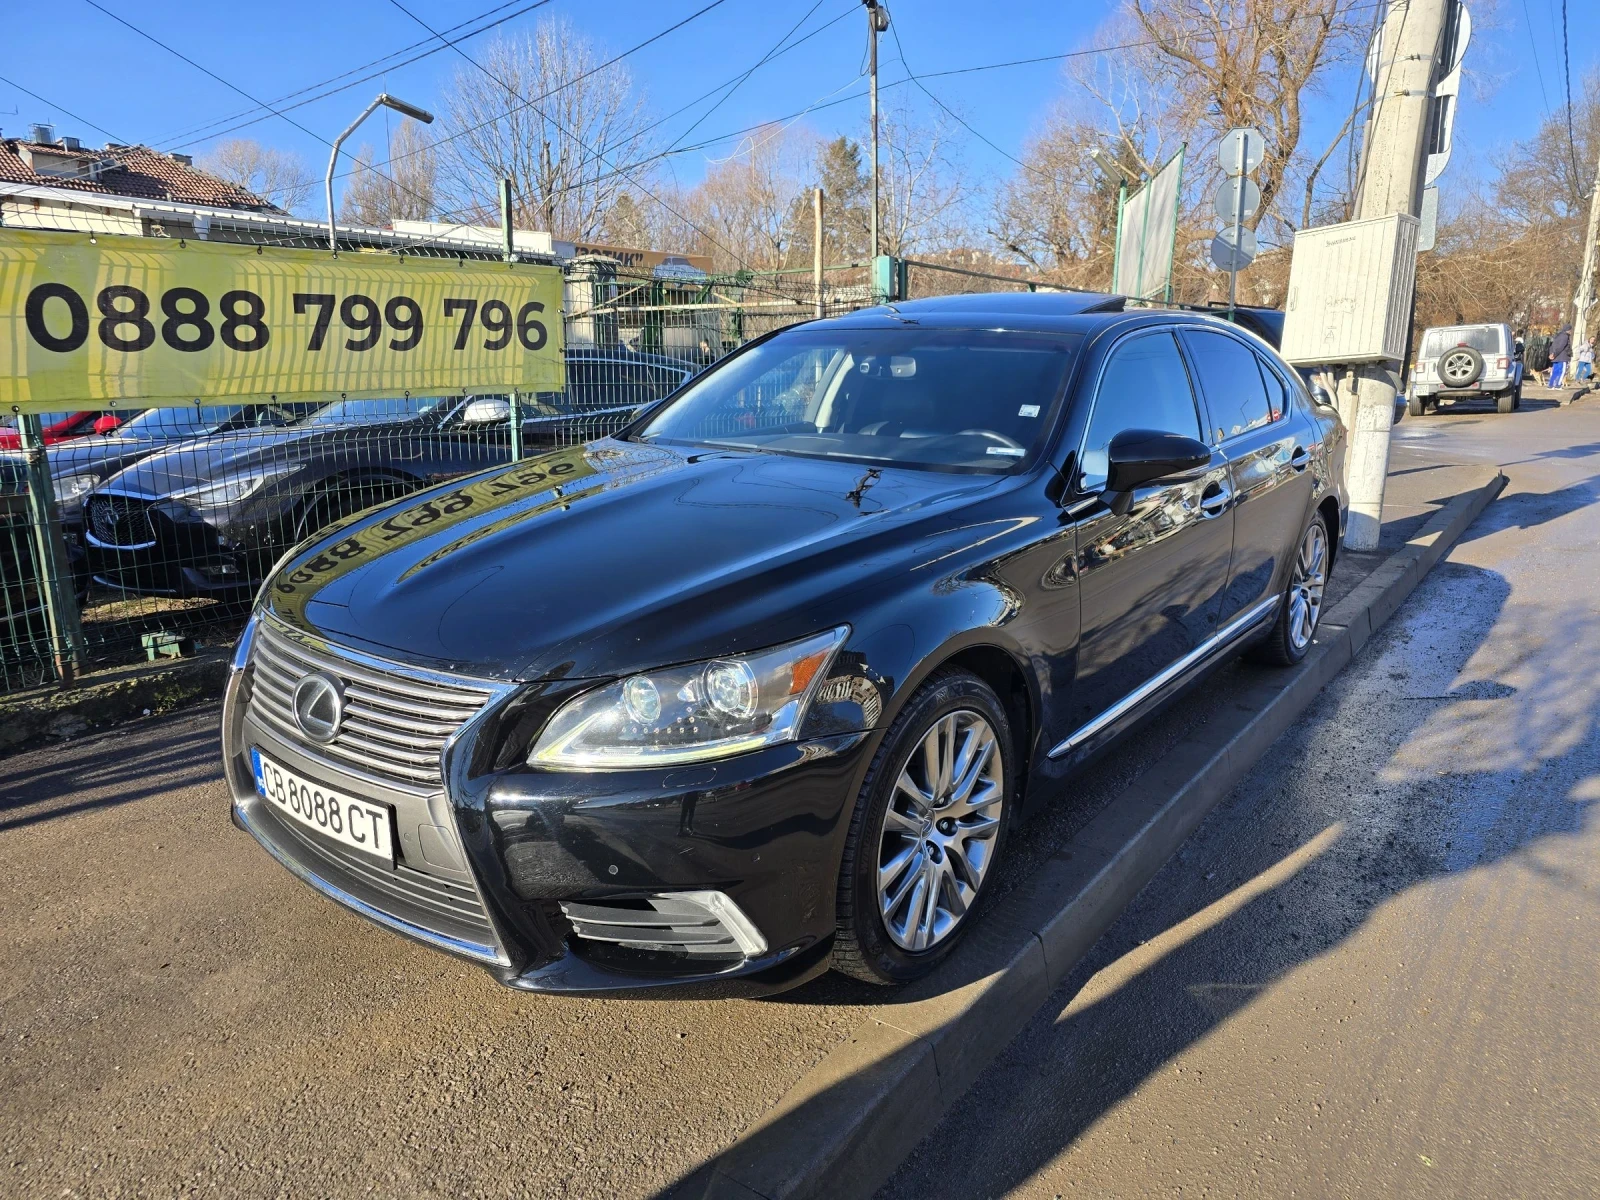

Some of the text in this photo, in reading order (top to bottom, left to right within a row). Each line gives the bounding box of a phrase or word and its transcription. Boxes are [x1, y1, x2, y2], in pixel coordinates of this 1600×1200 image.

[25, 283, 548, 352] 0888 799 796
[263, 762, 382, 848] CB 8088 CT
